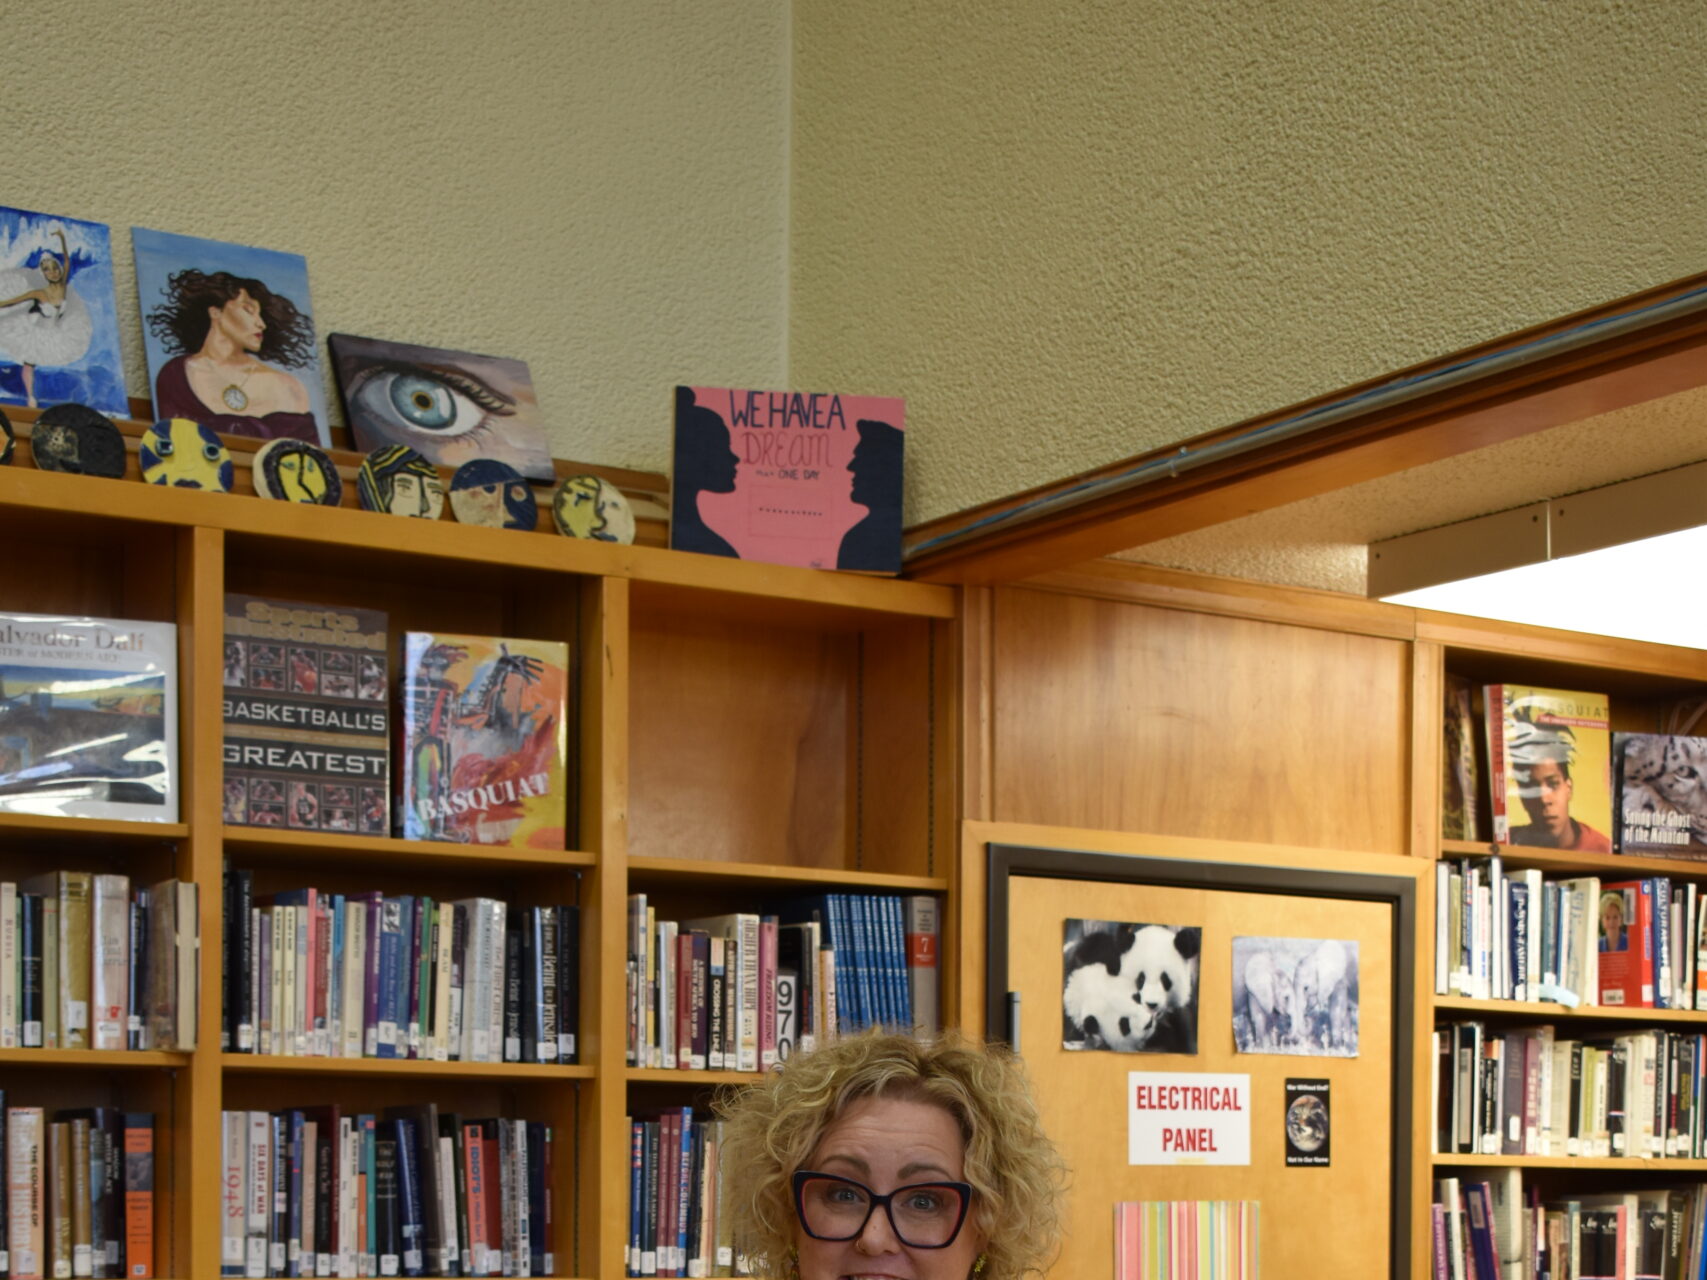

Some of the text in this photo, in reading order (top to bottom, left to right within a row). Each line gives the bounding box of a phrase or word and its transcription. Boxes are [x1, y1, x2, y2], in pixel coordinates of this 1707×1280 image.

[729, 390, 846, 431] WE HAVE A
[778, 469, 799, 480] ONE
[0, 625, 85, 648] alvador
[222, 701, 386, 731] BASKETBALL'S
[222, 744, 386, 775] GREATEST
[418, 772, 549, 821] BASQUIAT
[1660, 881, 1669, 942] CULTURAL
[921, 937, 930, 954] 7
[543, 955, 557, 987] Beirut
[712, 979, 721, 1017] CROSSING
[765, 968, 773, 1011] FREEDOM
[712, 1018, 721, 1032] THE
[1137, 1086, 1241, 1111] ELECTRICAL
[257, 1144, 266, 1157] SIX
[1162, 1128, 1217, 1152] PANEL
[257, 1160, 266, 1181] DAYS
[221, 1165, 244, 1218] 1948
[257, 1196, 266, 1214] WAR
[679, 1151, 690, 1233] BEFORE COLUMBUS
[32, 1213, 38, 1228] OF
